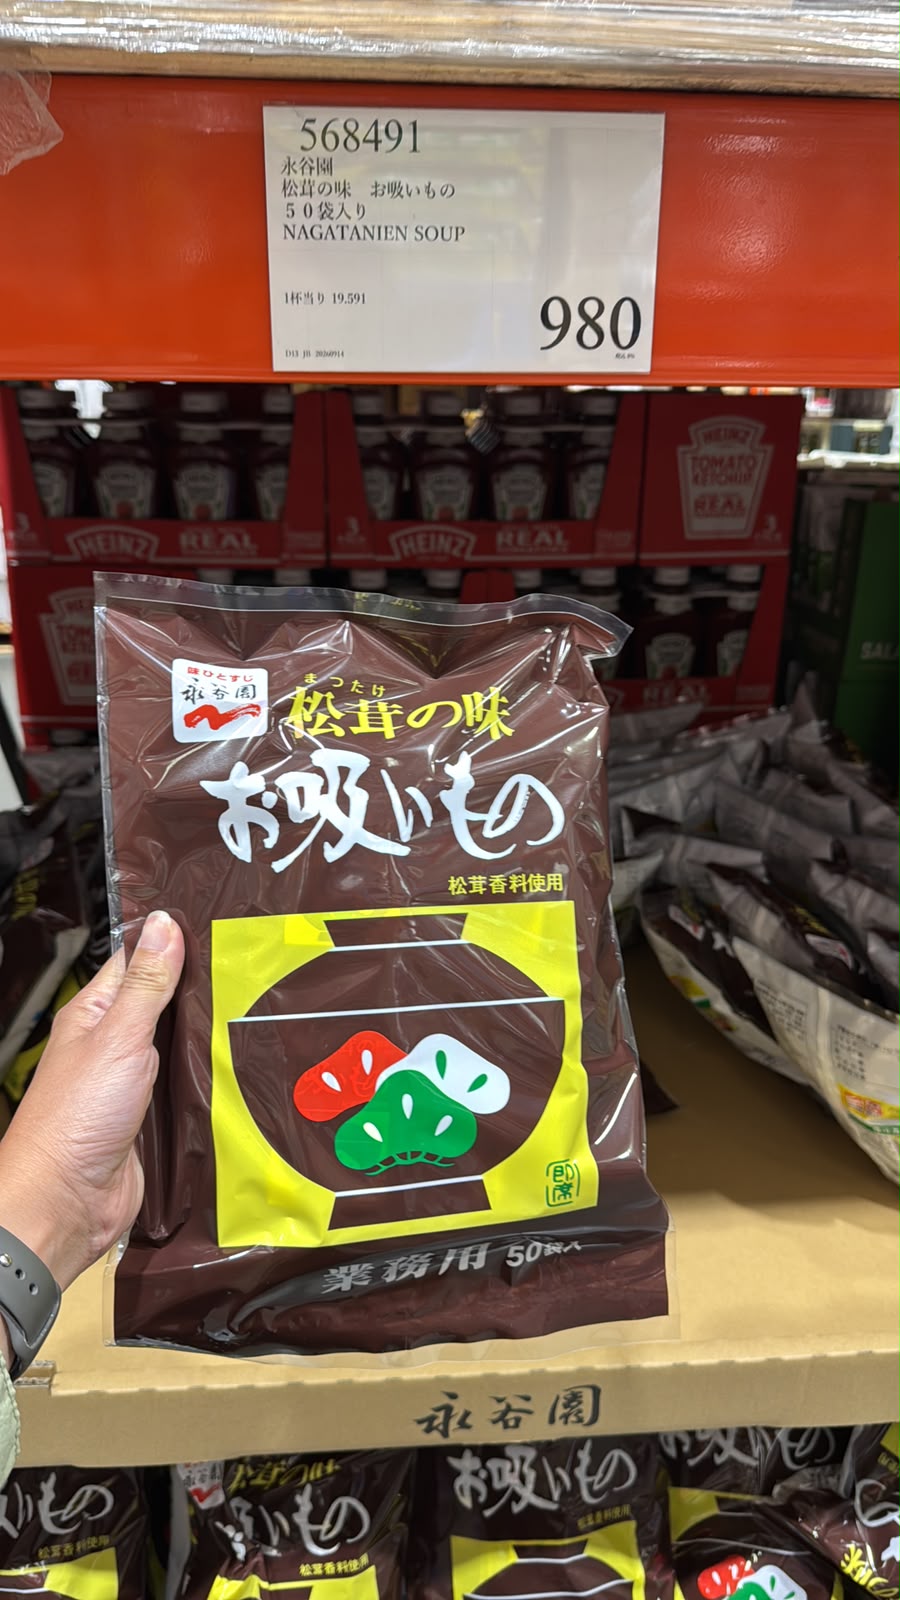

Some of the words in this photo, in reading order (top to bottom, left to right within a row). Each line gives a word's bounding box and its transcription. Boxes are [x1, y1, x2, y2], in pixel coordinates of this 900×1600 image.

[300, 118, 421, 153] 568491
[281, 157, 333, 176] 永谷園
[281, 181, 351, 199] 松茸の味
[370, 181, 455, 199] お吸いもの
[283, 224, 408, 242] NAGATANIEN
[414, 224, 465, 242] SOUP
[333, 292, 366, 305] 19.591
[540, 296, 642, 351] 980
[691, 454, 757, 472] TOMATO
[694, 494, 746, 514] REAL
[76, 535, 149, 559] HEINZ
[180, 530, 257, 549] REAL
[399, 532, 469, 557] HEINZ
[496, 529, 569, 548] REAL
[187, 667, 253, 682] 味ひとすじ
[304, 673, 386, 698] まつたけ
[180, 676, 256, 705] 永谷園
[285, 686, 515, 740] 松茸の味
[200, 749, 566, 873] お吸いもの
[448, 873, 564, 896] 松茸香料使用
[321, 1241, 493, 1294] 業務用
[413, 1383, 602, 1440] 永谷園
[448, 1440, 636, 1517] お吸いもの
